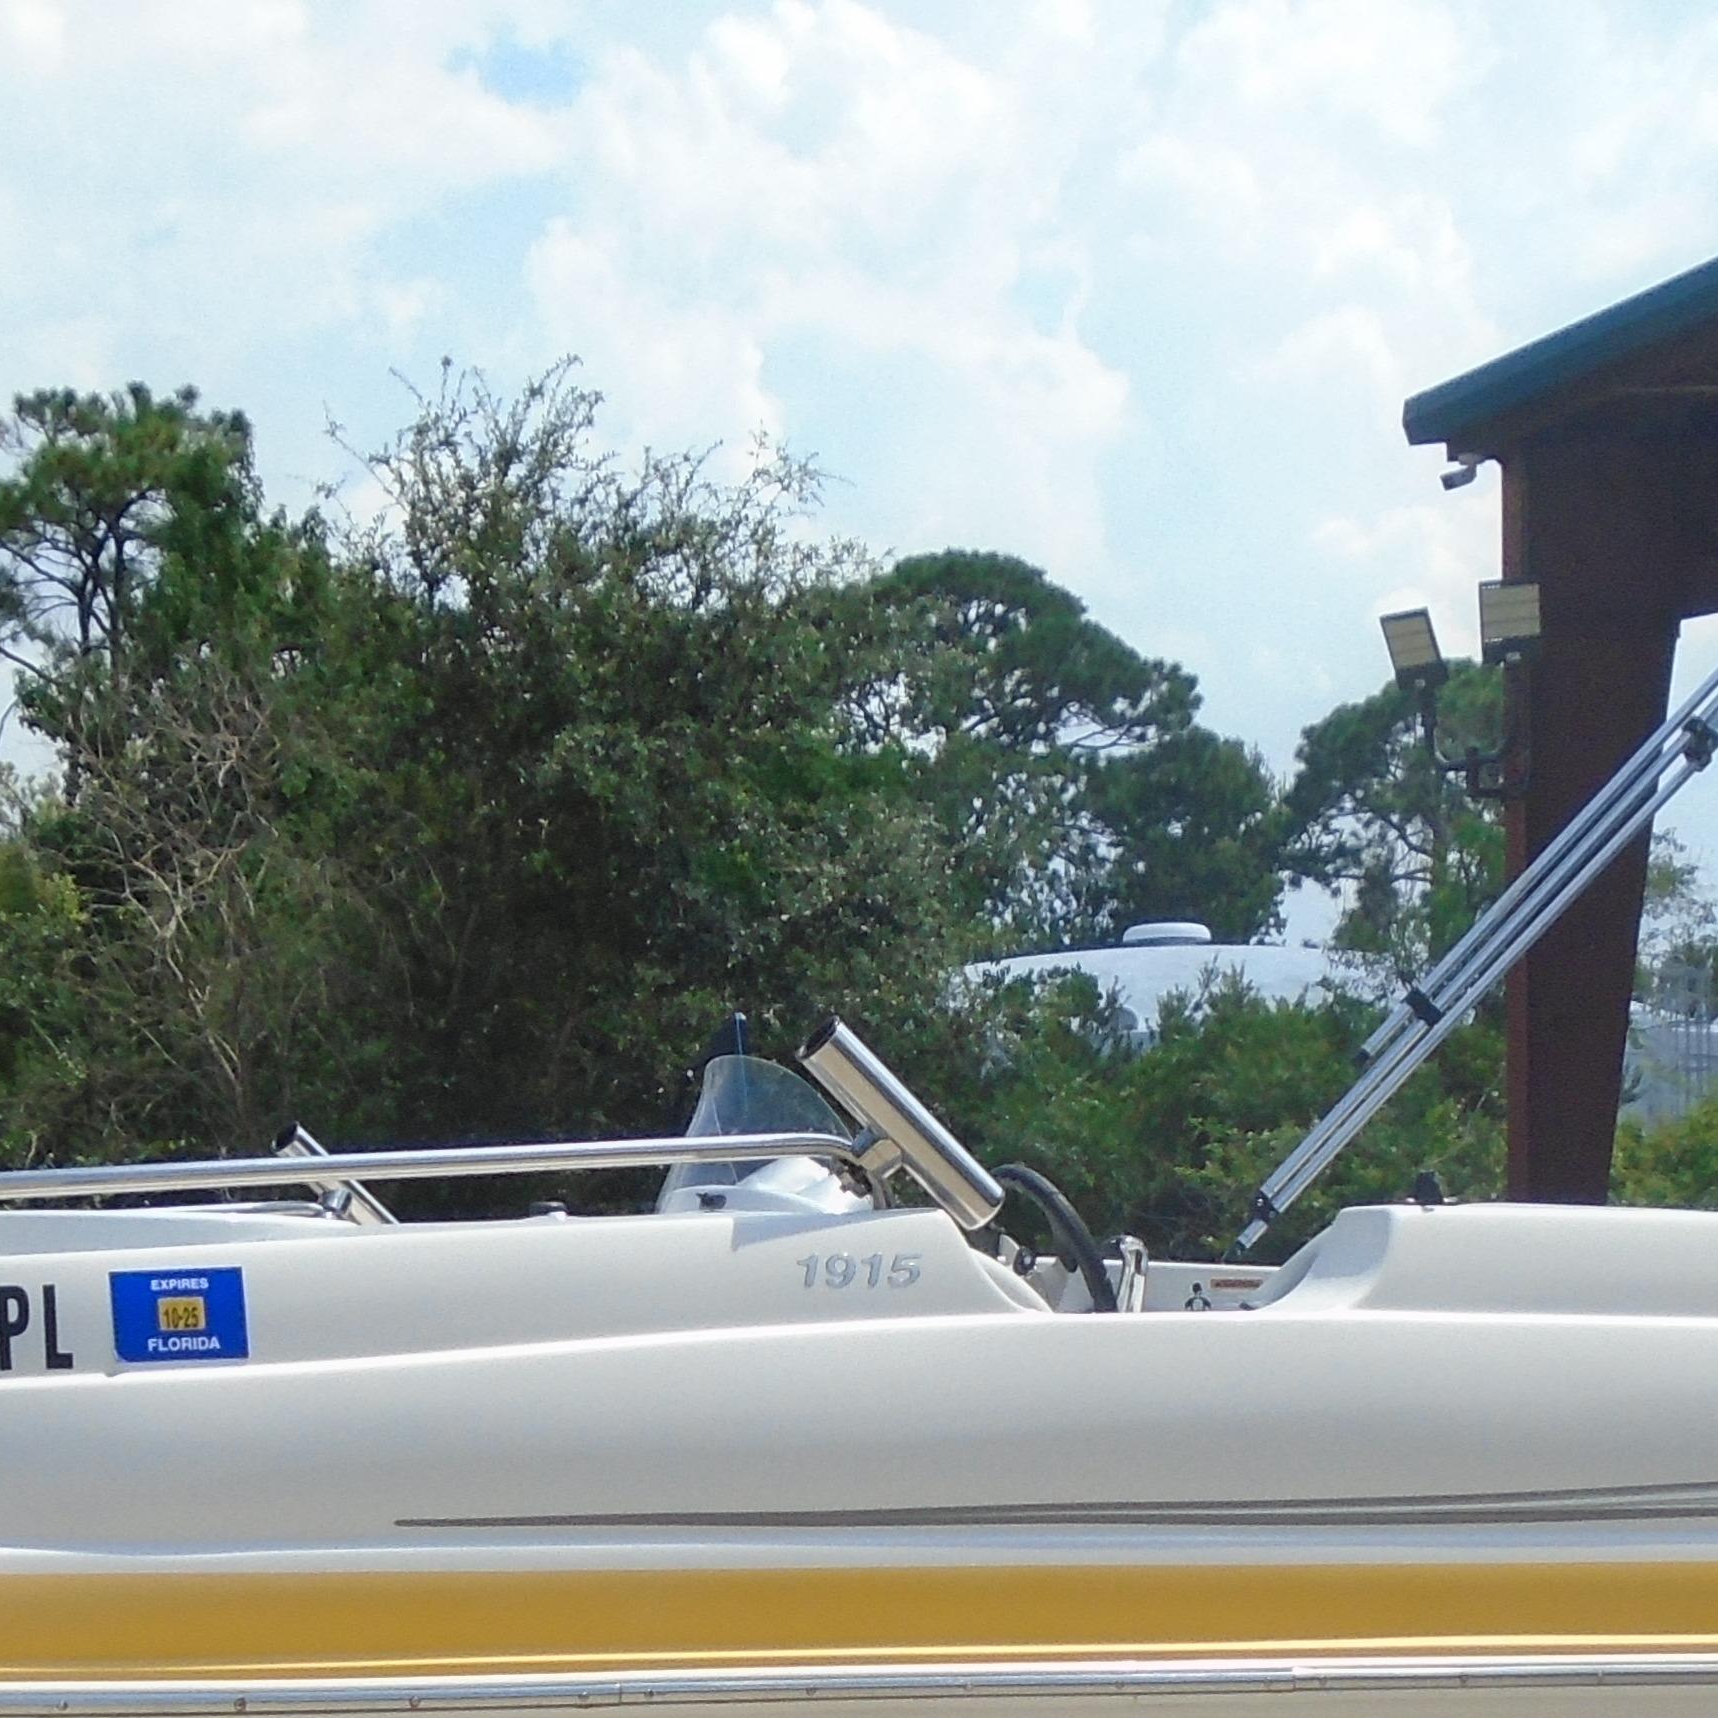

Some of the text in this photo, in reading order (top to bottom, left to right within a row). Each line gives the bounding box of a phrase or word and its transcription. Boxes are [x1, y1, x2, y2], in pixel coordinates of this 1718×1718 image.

[796, 1251, 923, 1289] 1915
[149, 1277, 209, 1291] EXPIRES
[147, 1336, 221, 1351] FLORIDA
